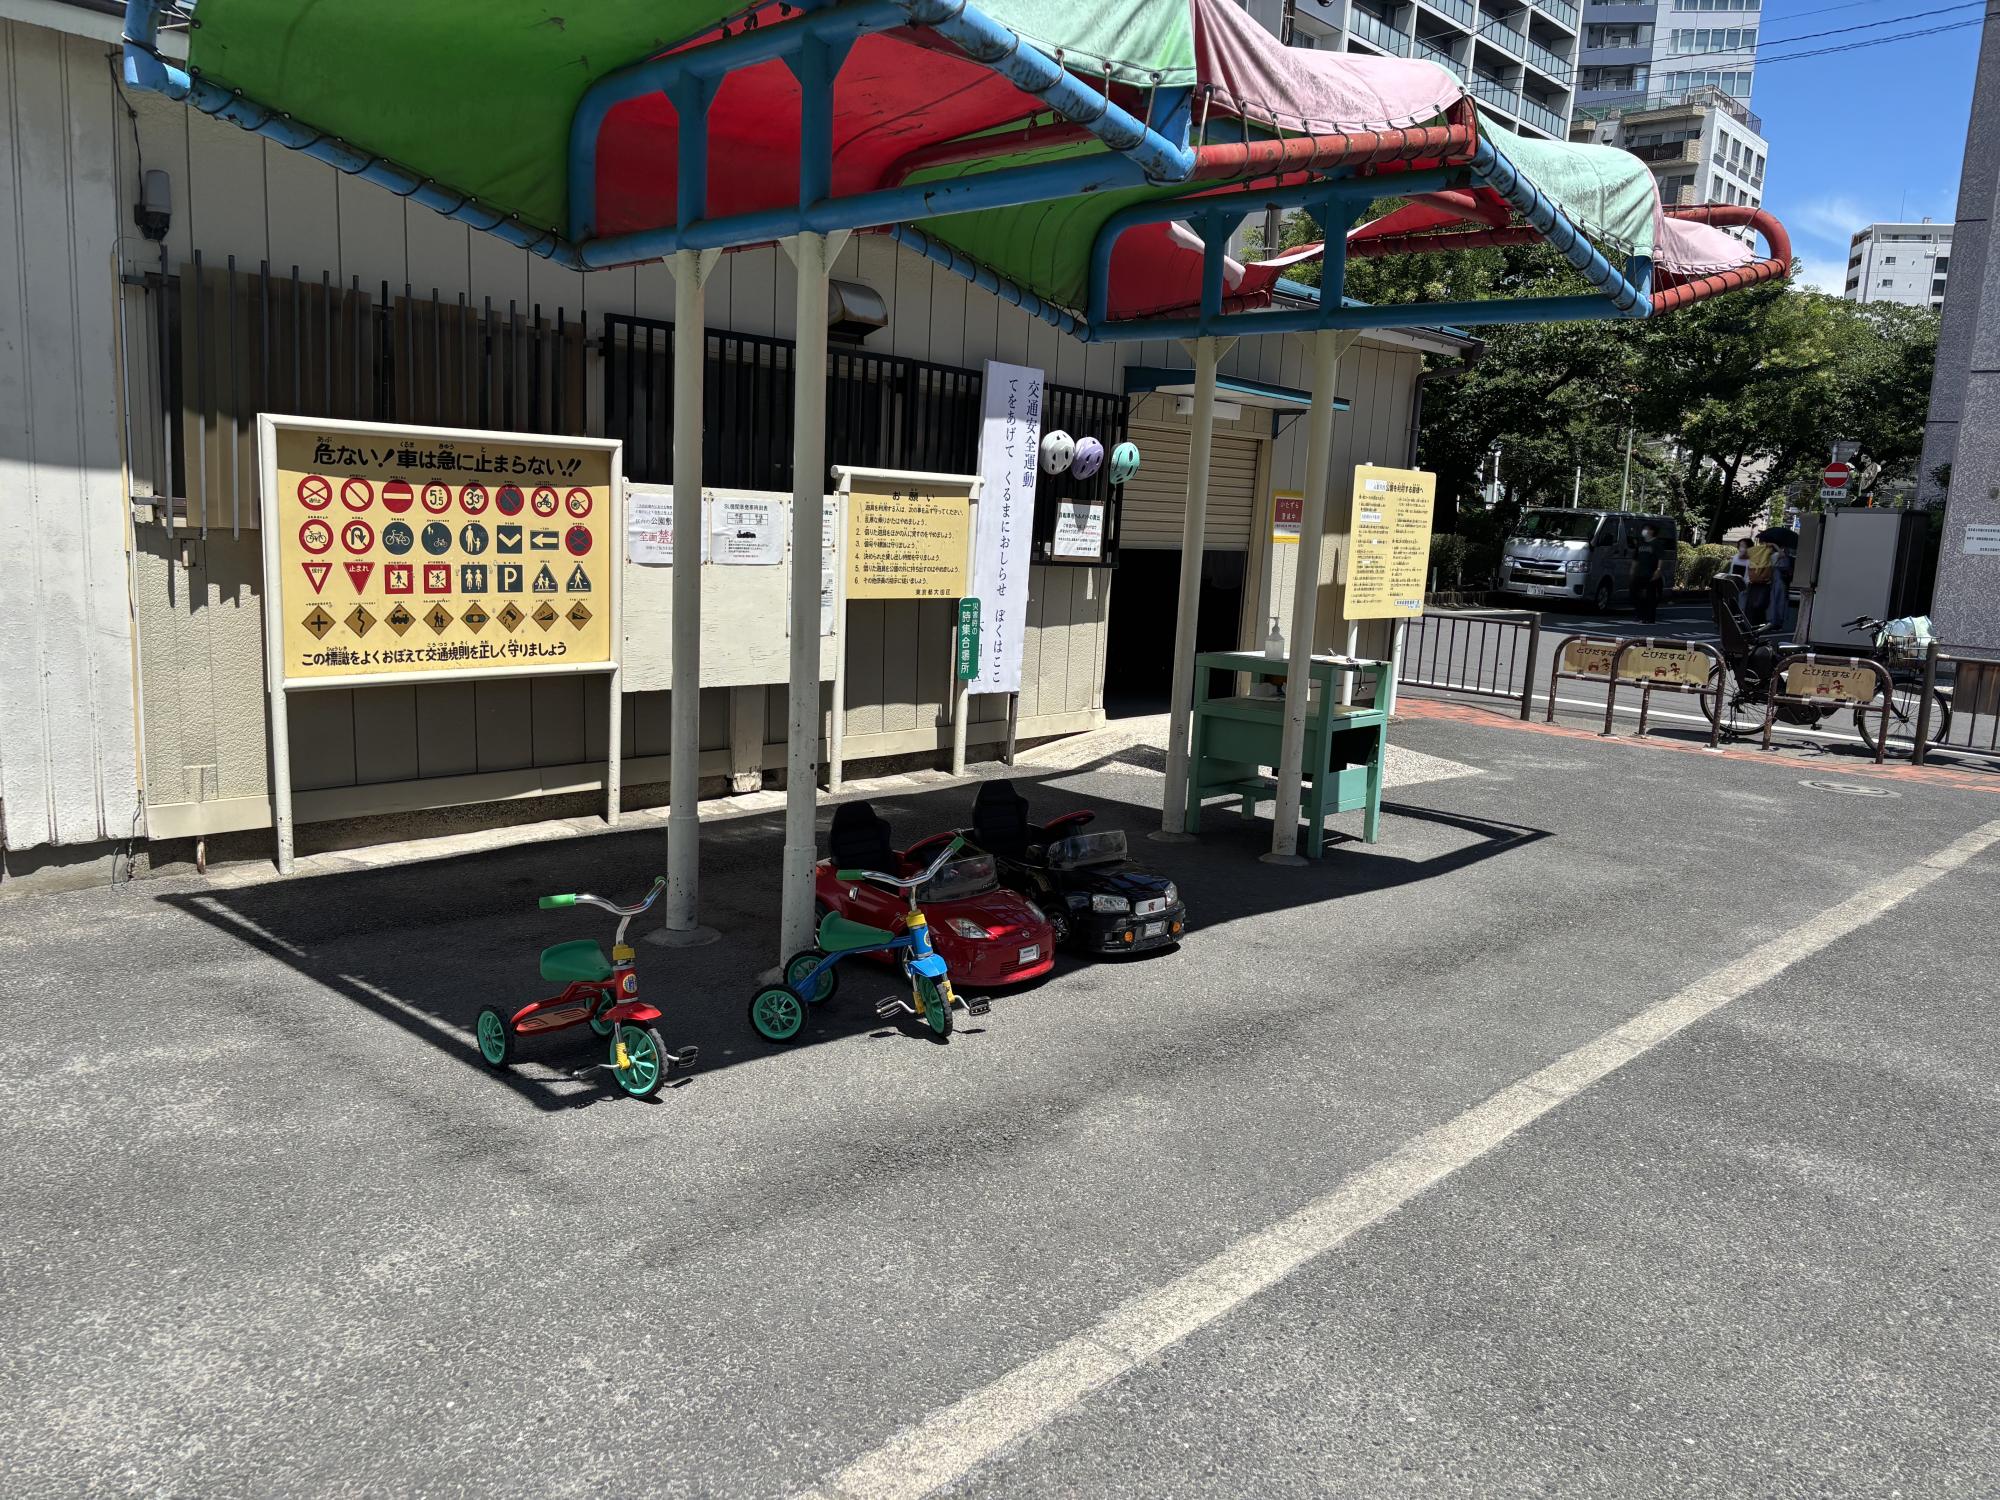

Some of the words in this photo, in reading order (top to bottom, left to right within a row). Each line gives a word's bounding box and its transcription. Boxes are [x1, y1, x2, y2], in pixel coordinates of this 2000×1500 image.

[1005, 378, 1018, 458] てをあげて
[1022, 380, 1040, 488] 交通安全運動
[639, 529, 673, 545] 全面禁
[997, 471, 1012, 597] くるまにおしらせ
[348, 565, 370, 573] 止まれ
[504, 567, 518, 591] P
[961, 603, 972, 674] 一時集合場所
[971, 602, 979, 635] 災害時の
[302, 641, 567, 666] この標識をよくおぼえて交通規則を正しく守りましょう
[993, 609, 1006, 683] ぼくはここ
